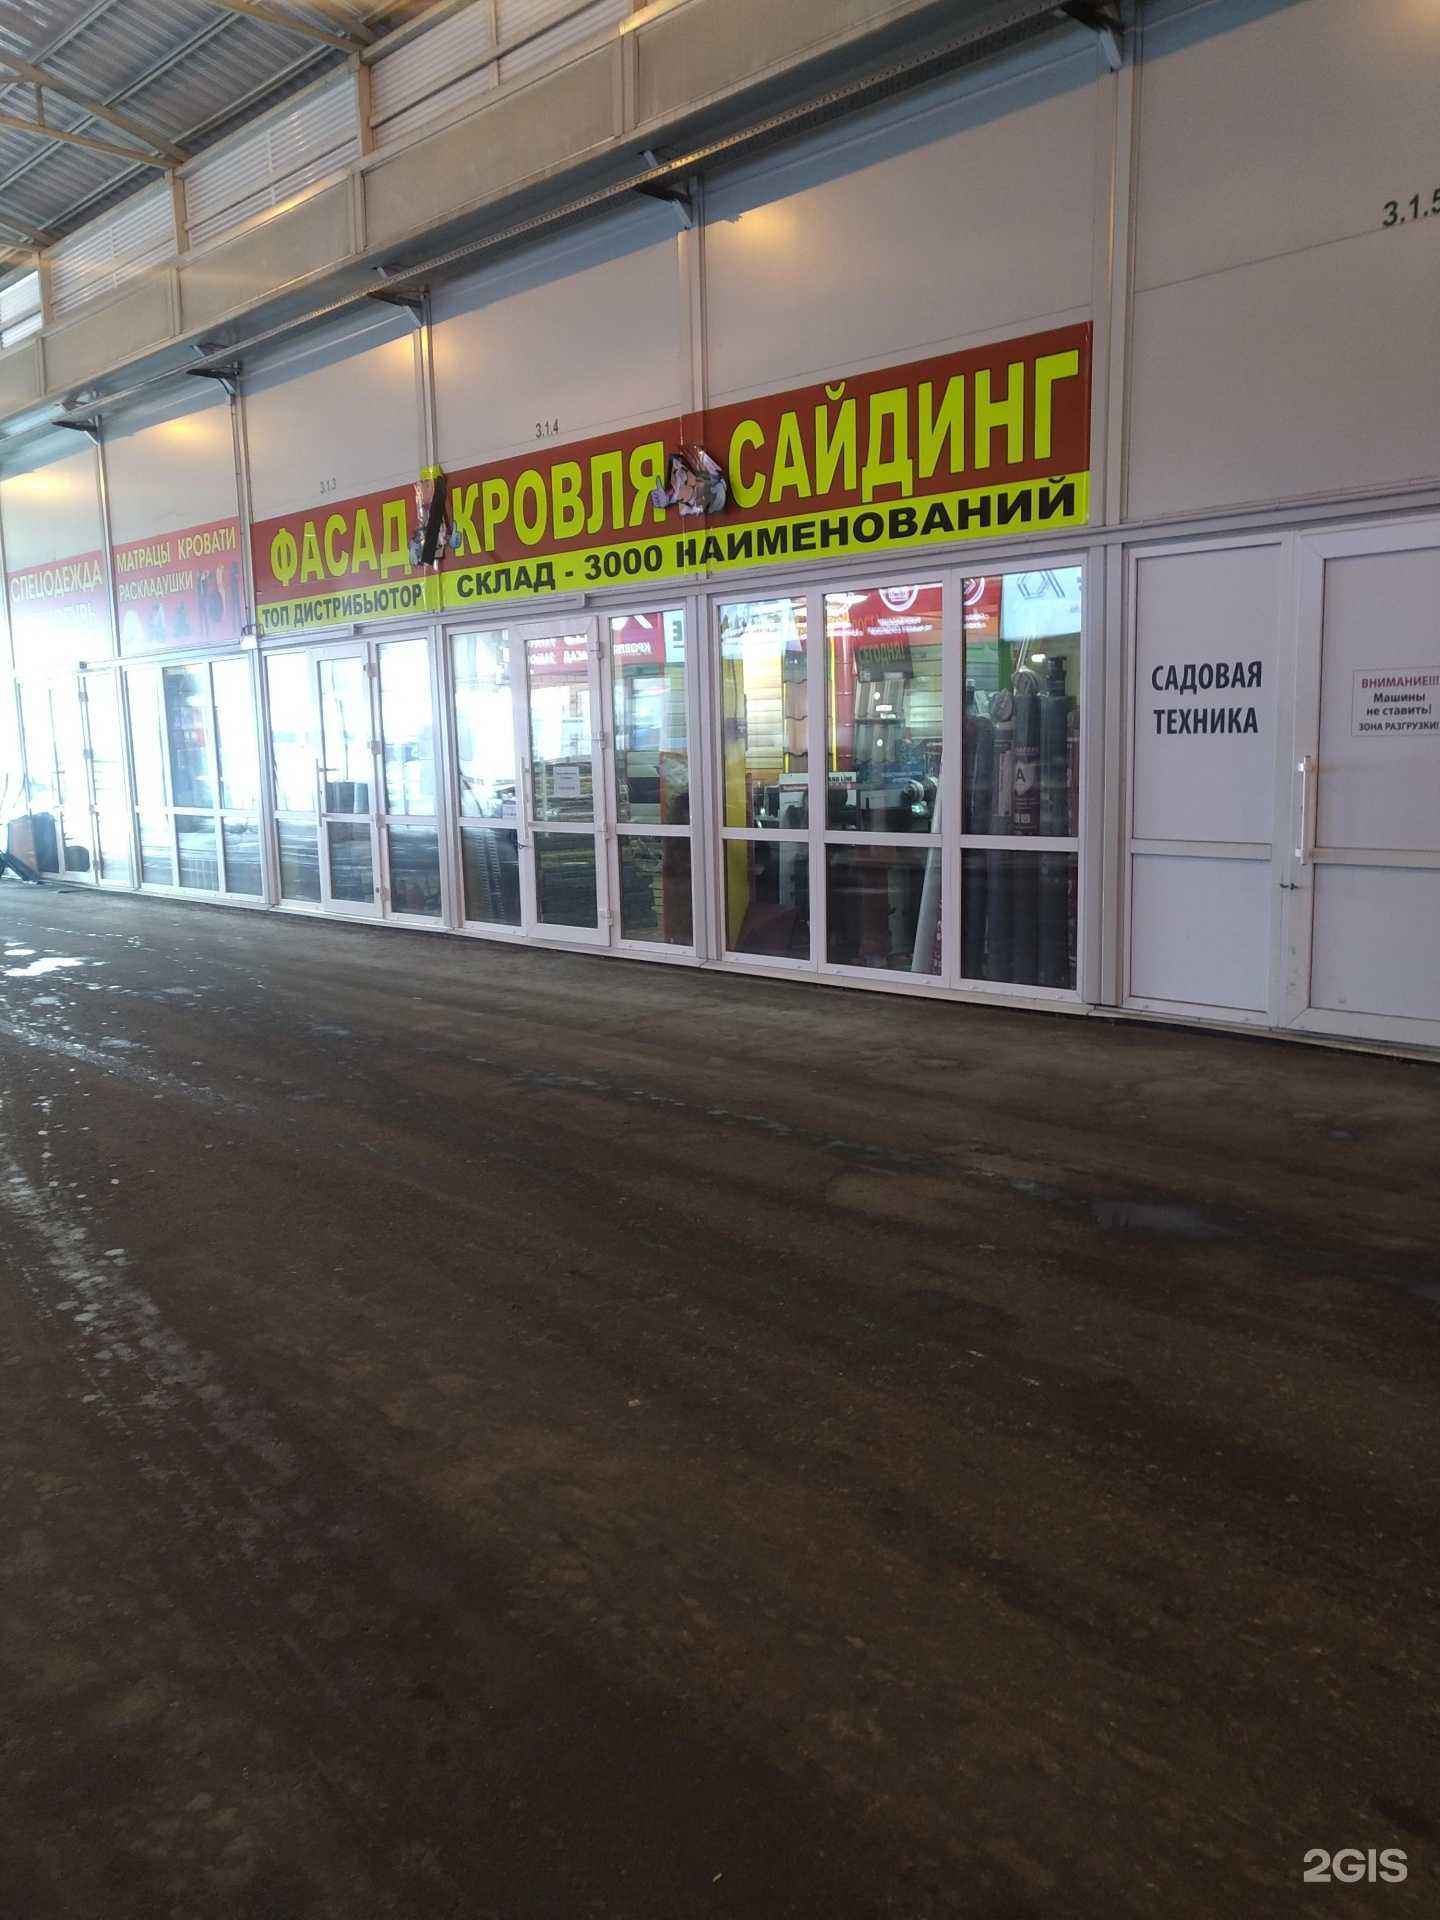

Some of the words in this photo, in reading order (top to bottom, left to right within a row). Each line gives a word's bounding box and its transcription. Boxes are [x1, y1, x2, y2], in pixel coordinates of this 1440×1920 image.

[536, 419, 559, 439] 3.1.4
[270, 499, 412, 587] ФАСАД
[451, 441, 666, 557] КРОВЛЯ
[728, 349, 1079, 508] САЙДИНГ
[116, 542, 171, 573] МАТРАЦЫ
[178, 526, 236, 560] КРОВАТИ
[456, 561, 556, 598] СКЛАД
[584, 544, 663, 580] 3000
[676, 476, 1075, 568] НАИМЕНОВАНИЙ
[9, 560, 103, 602] СПЕЦОДЕЖДА
[118, 571, 193, 602] РАСКЛАДУШКИ
[262, 606, 290, 628] ТОП
[294, 583, 423, 626] ДИСТРИБЬЮТОР
[1151, 661, 1262, 695] САДОВАЯ
[1361, 675, 1440, 688] ВНИМАНИЕ!!!
[1366, 708, 1380, 716] не
[1382, 703, 1432, 716] ставить!
[1373, 692, 1426, 703] Машины
[1153, 706, 1259, 735] ТЕХНИКА
[1359, 722, 1383, 731] ЗОНА
